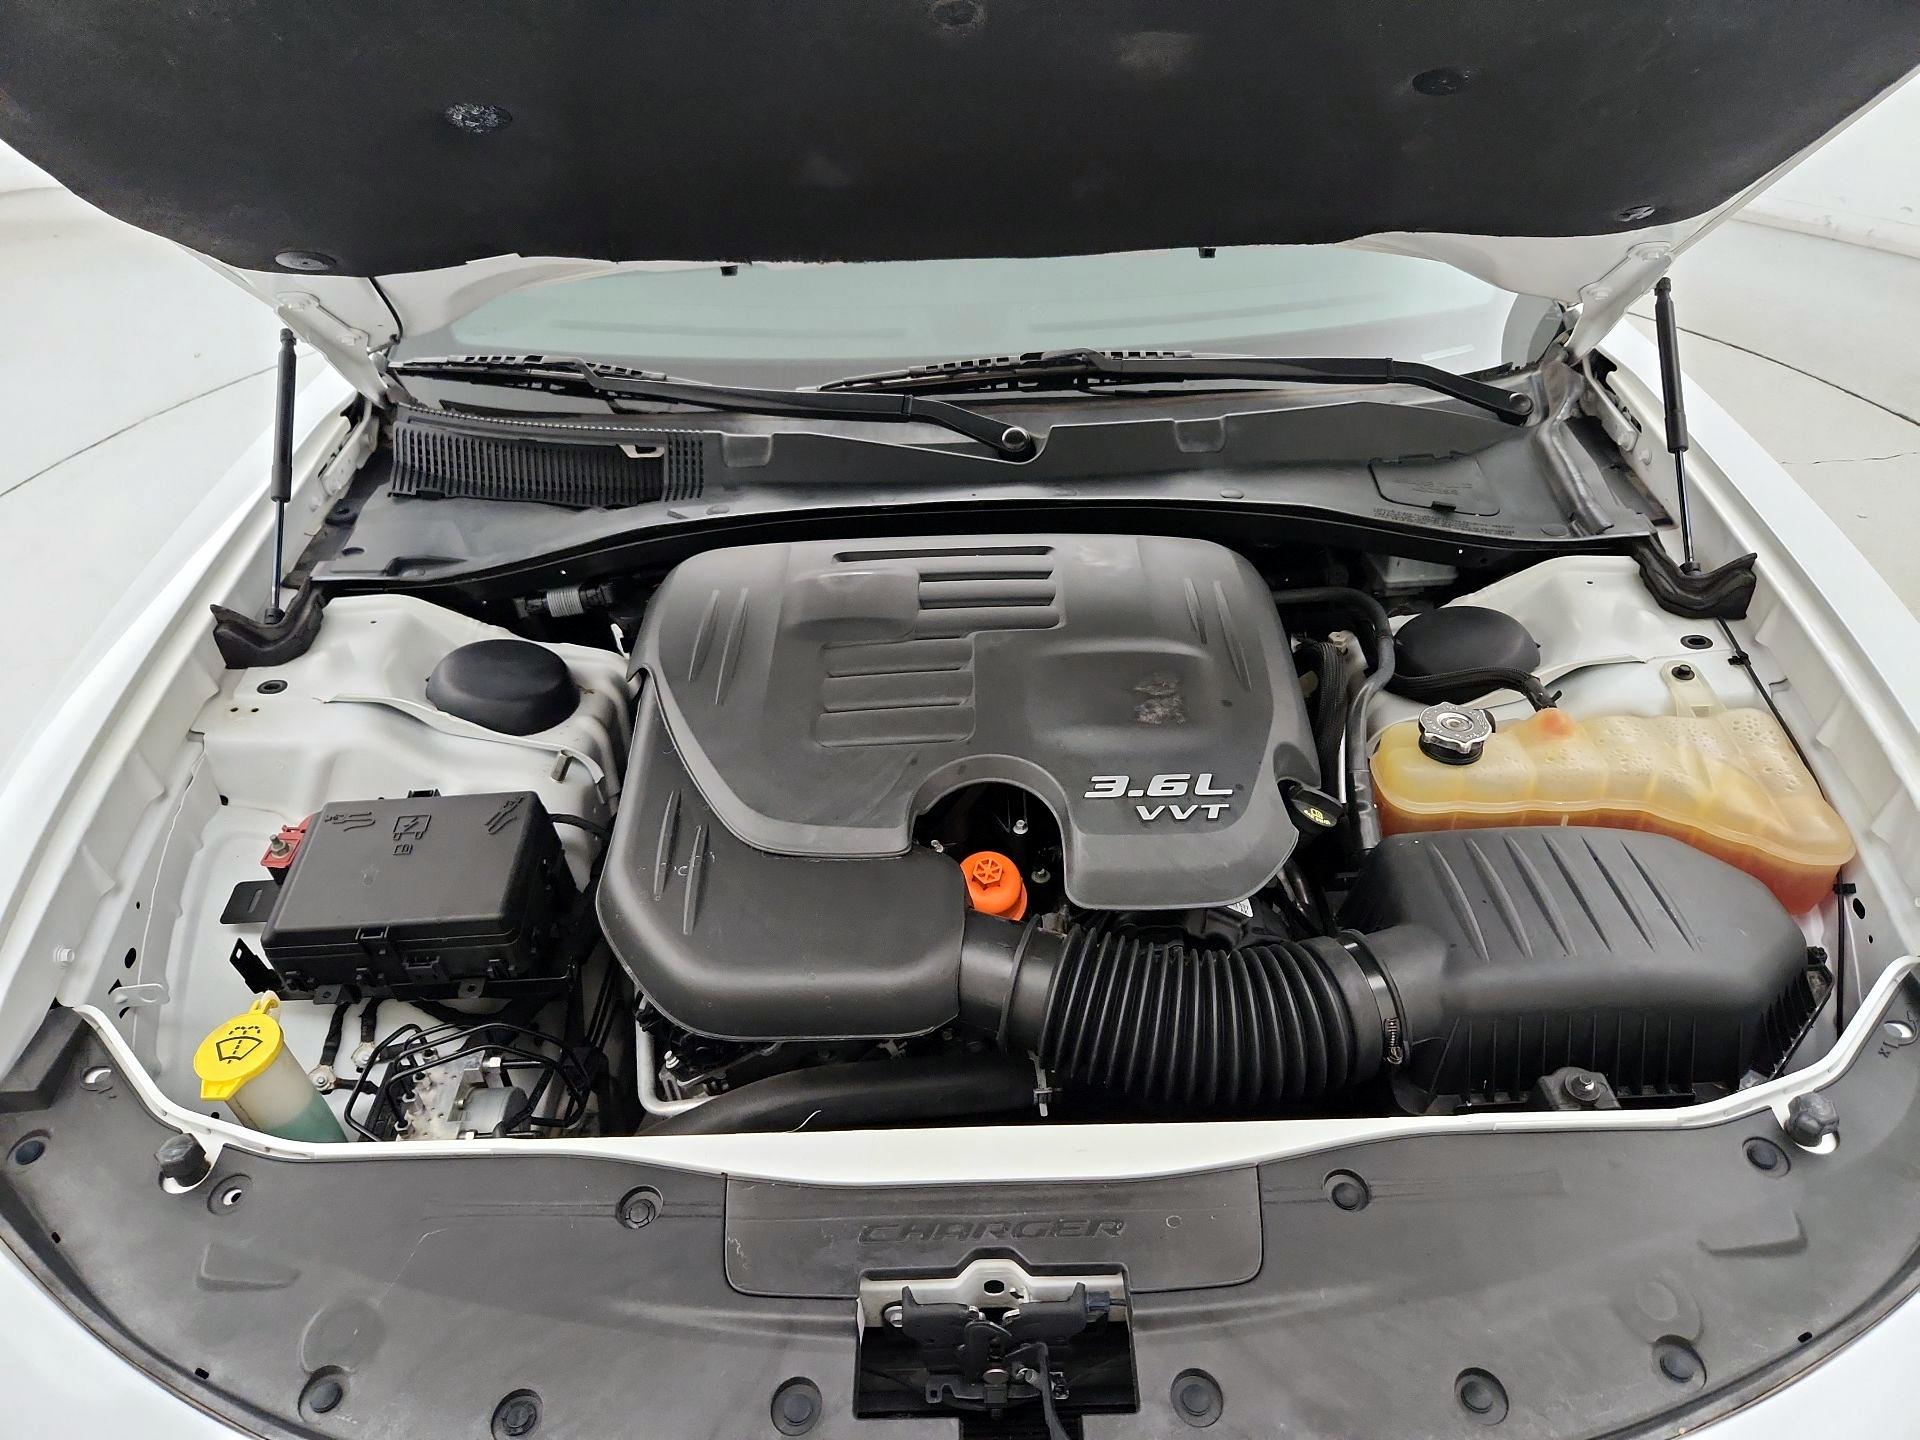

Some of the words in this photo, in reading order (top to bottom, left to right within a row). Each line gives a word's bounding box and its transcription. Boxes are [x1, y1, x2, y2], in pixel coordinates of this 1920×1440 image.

[1084, 773, 1234, 798] 3.6L
[1136, 804, 1230, 821] VVT
[858, 1219, 1126, 1244] CHARGER
